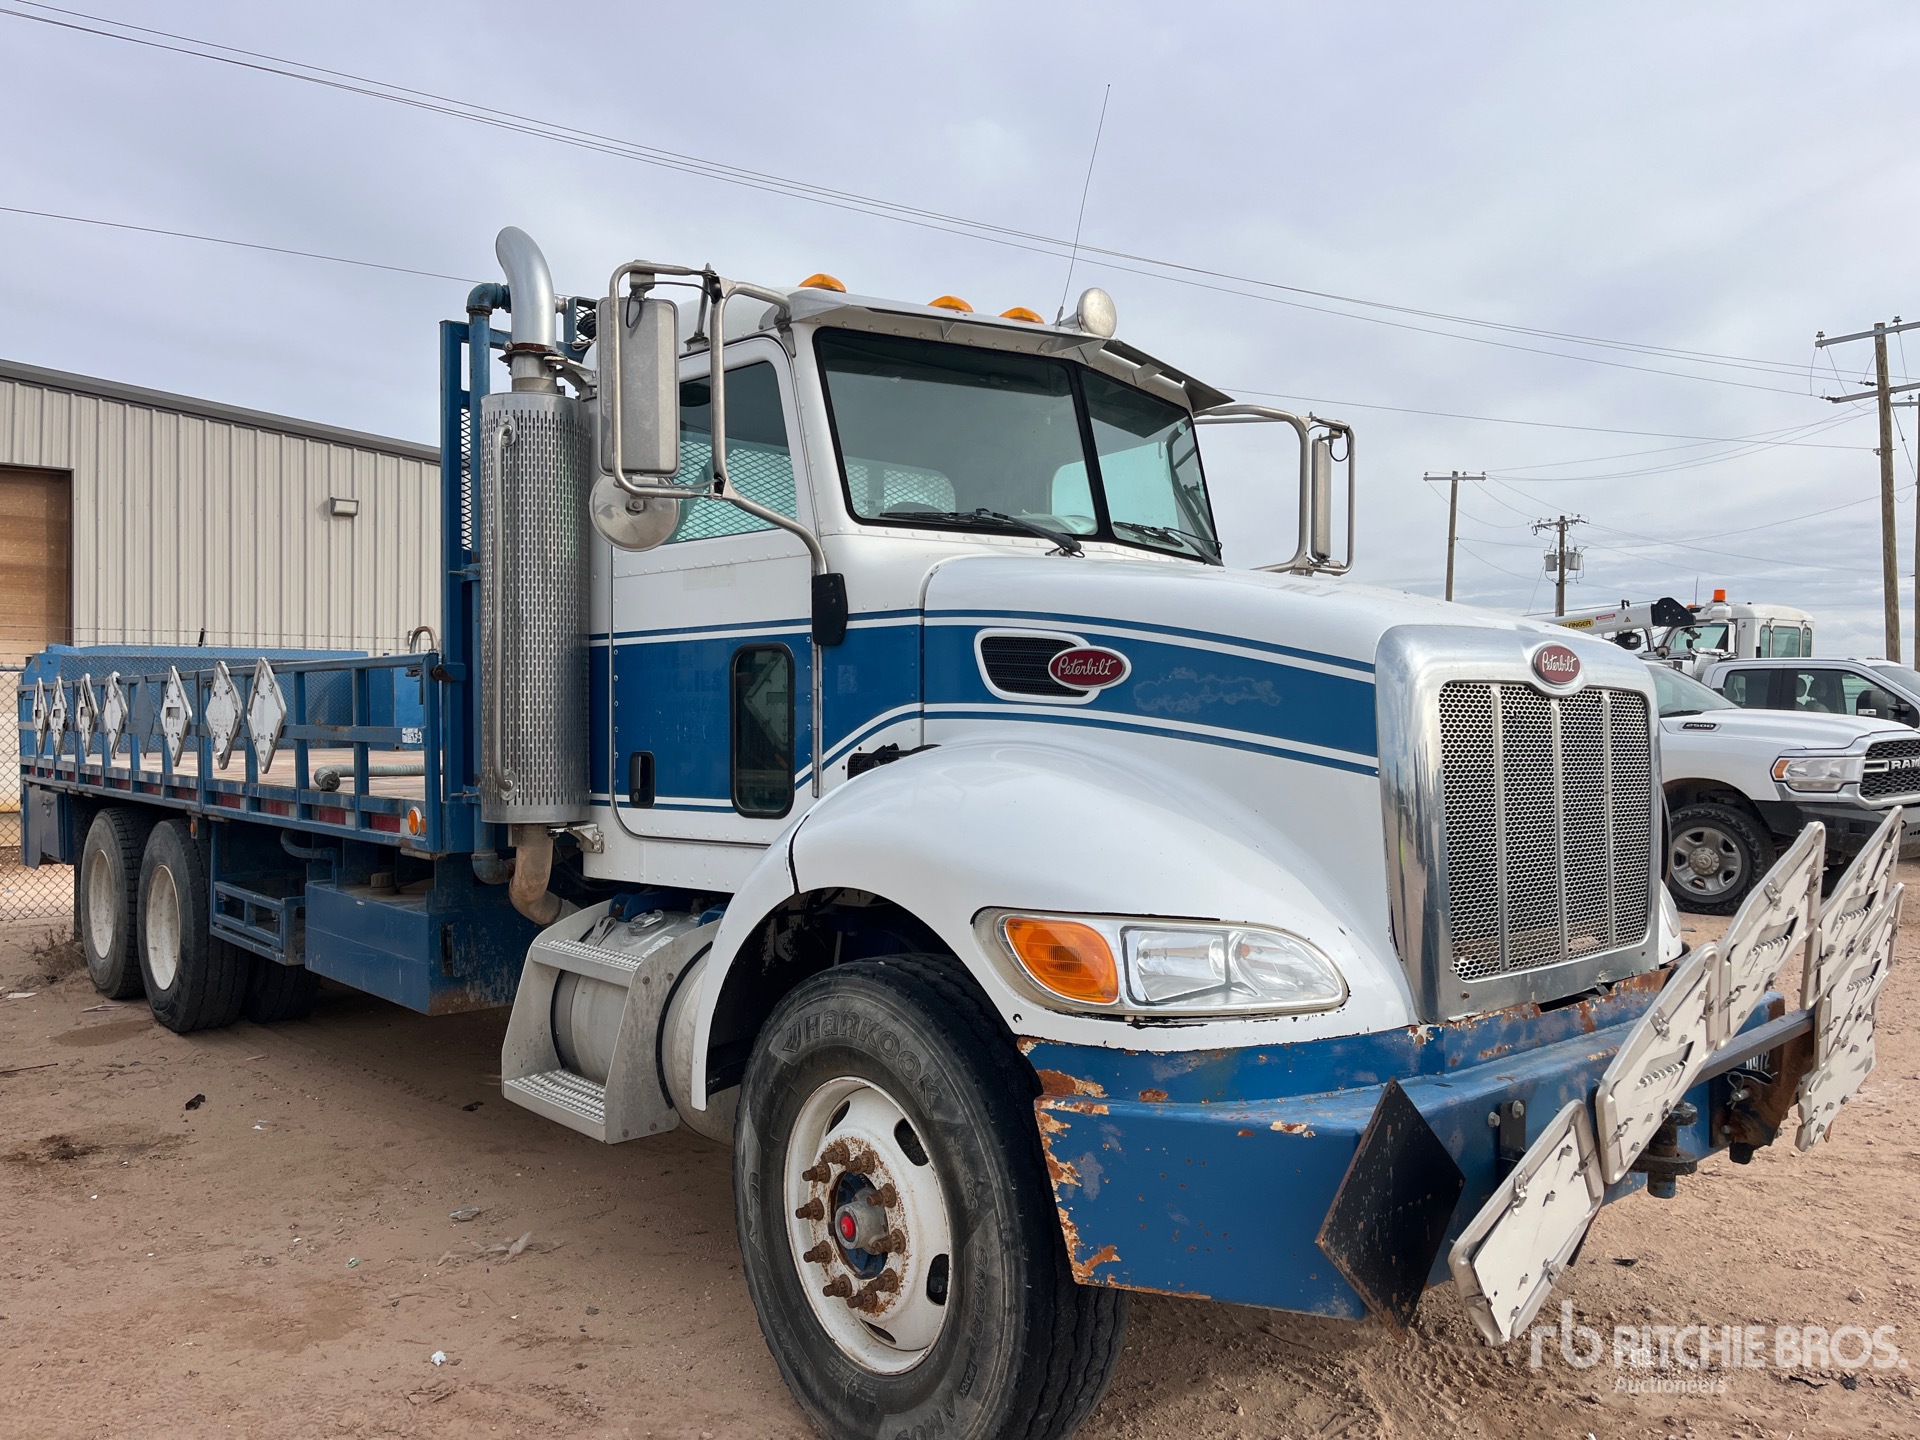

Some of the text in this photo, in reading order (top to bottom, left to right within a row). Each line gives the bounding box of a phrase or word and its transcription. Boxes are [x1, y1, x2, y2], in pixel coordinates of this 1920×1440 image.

[1057, 656, 1117, 677] Peterbilt
[1541, 651, 1577, 672] Peterbilt
[1891, 757, 1920, 770] RAM
